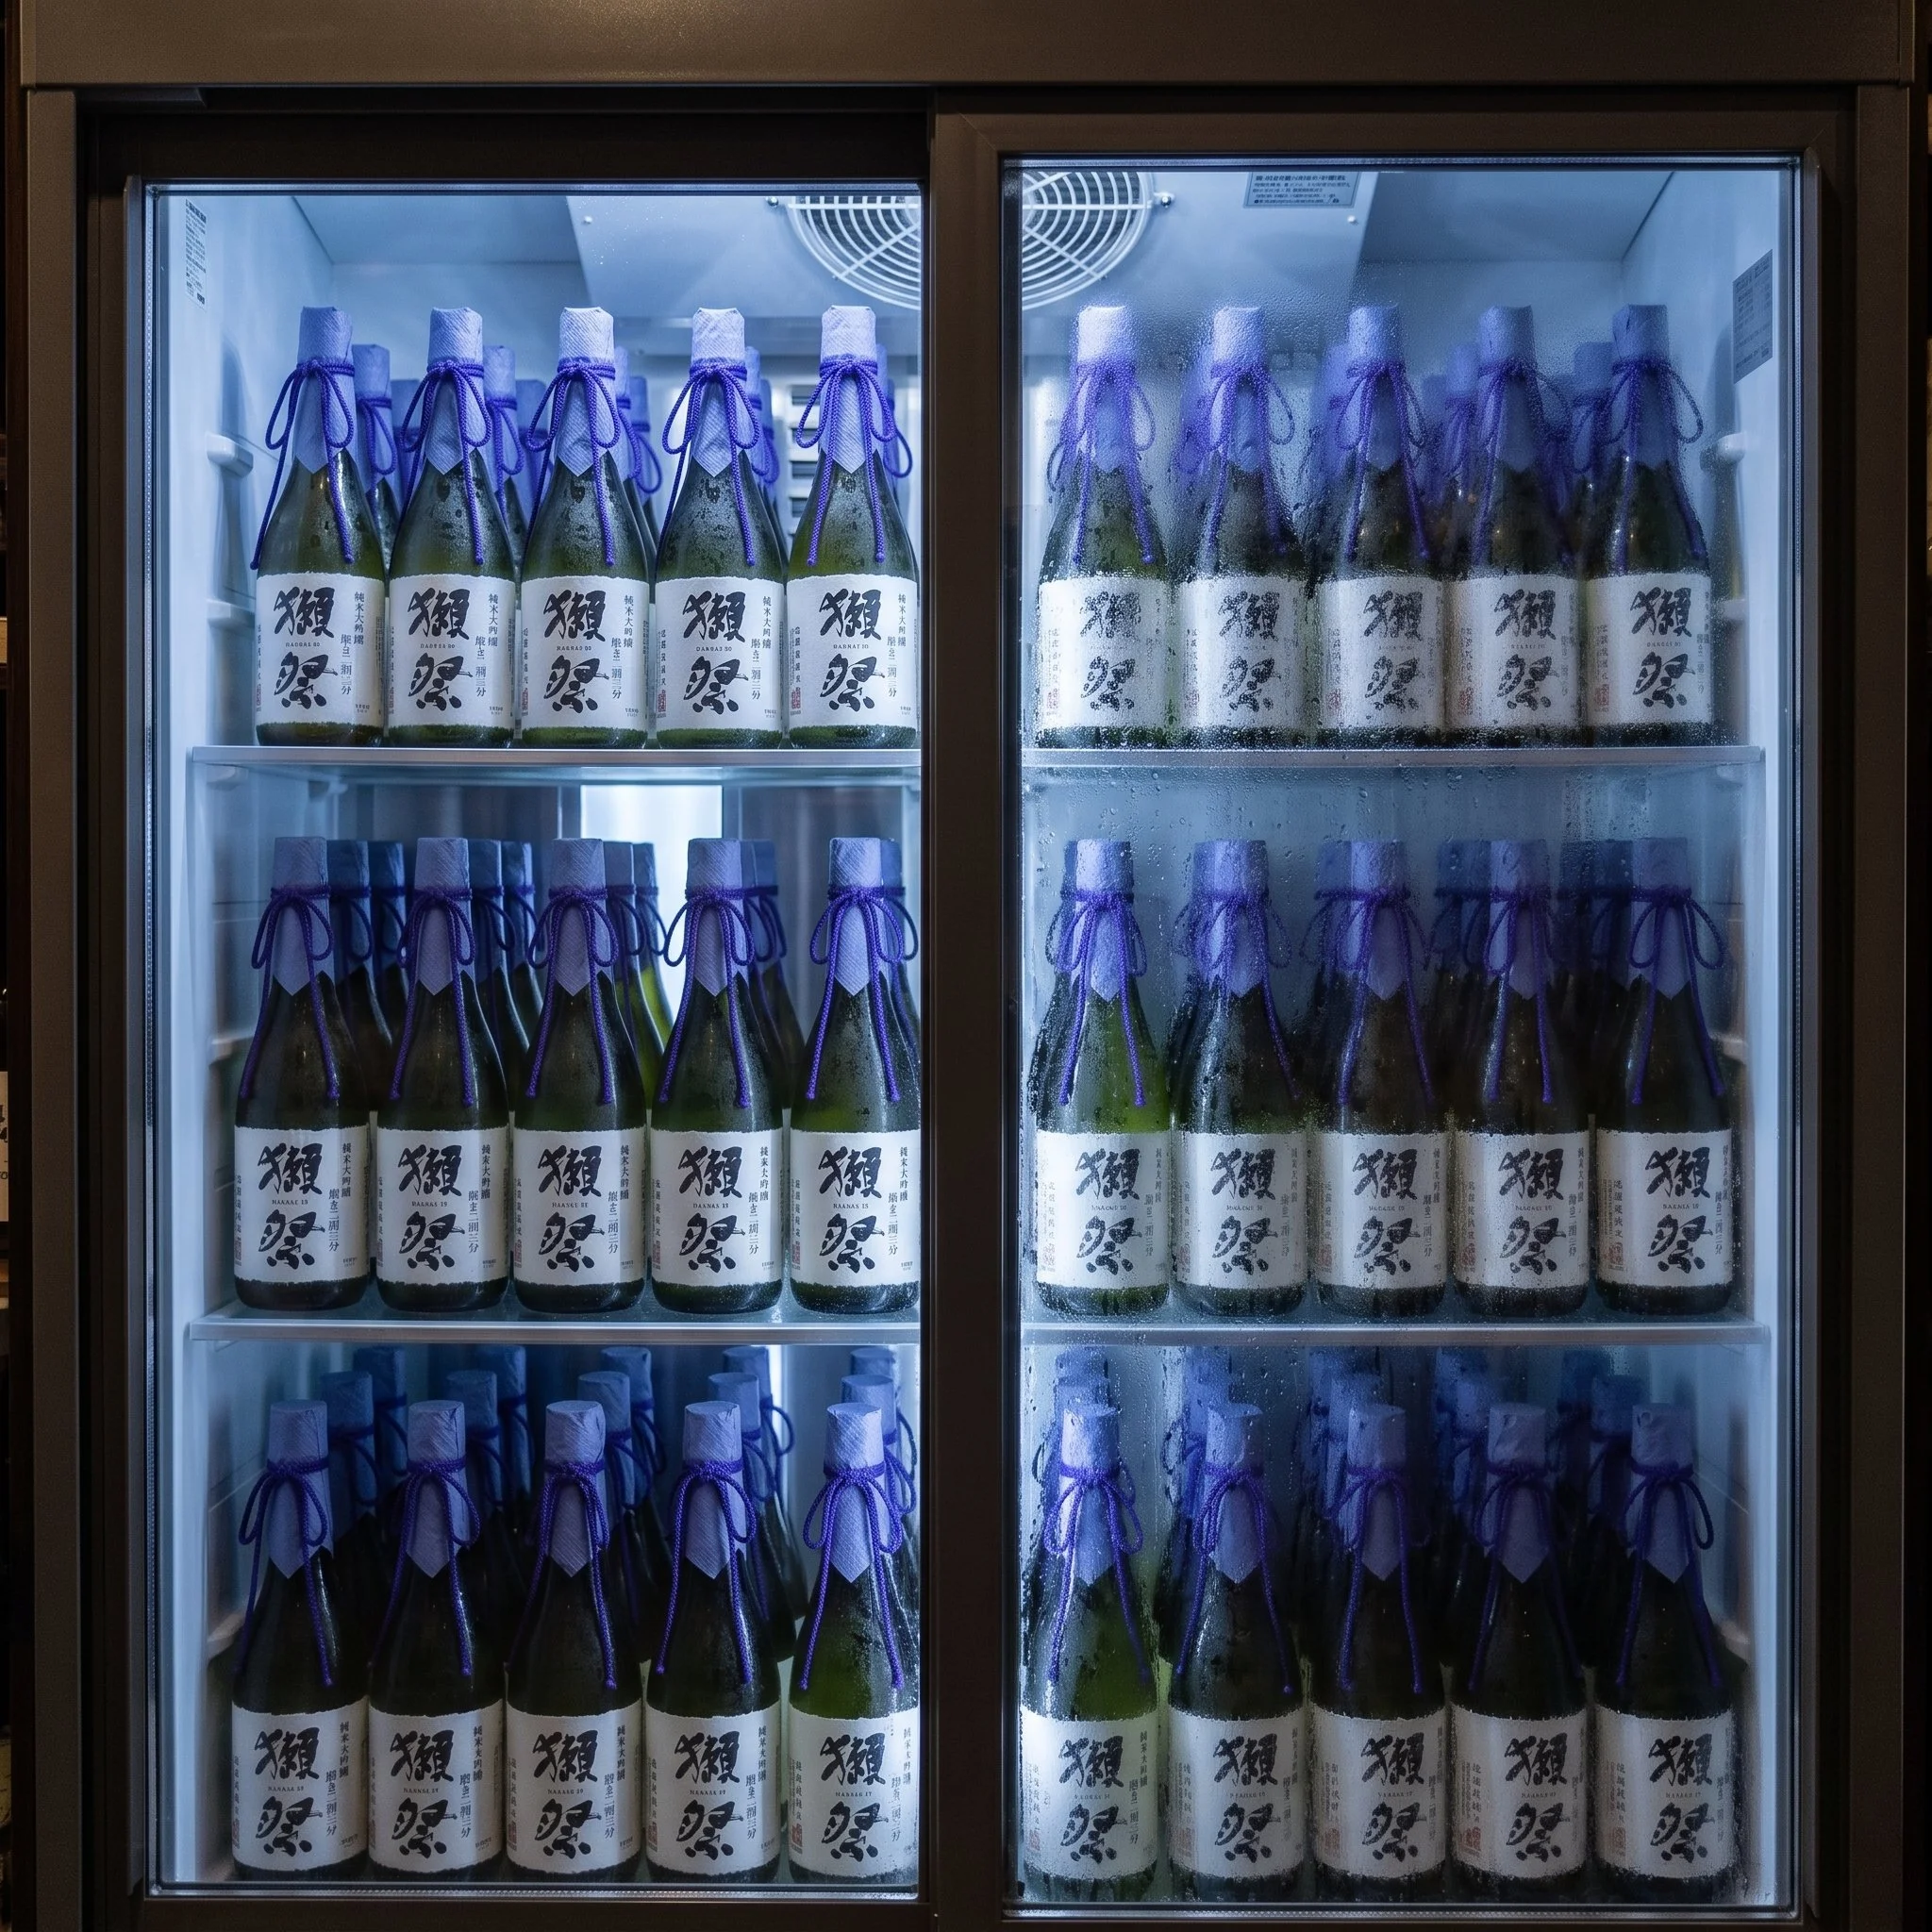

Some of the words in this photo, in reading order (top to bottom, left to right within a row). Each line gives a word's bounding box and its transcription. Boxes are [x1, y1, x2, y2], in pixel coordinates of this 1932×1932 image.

[274, 586, 337, 709] 獺祭
[408, 587, 472, 711] 獺祭
[543, 589, 608, 714] 獺祭
[682, 590, 748, 715] 獺祭
[819, 588, 883, 712] 獺祭
[258, 1141, 325, 1270] 獺祭
[397, 1143, 464, 1272] 獺祭
[537, 1144, 604, 1273] 獺祭
[677, 1145, 744, 1273] 獺祭
[818, 1146, 884, 1274] 獺祭
[254, 1727, 322, 1857] 獺祭
[390, 1729, 456, 1859] 獺祭
[532, 1729, 601, 1859] 獺祭
[674, 1731, 742, 1860] 獺祭
[819, 1733, 887, 1862] 獺祭
